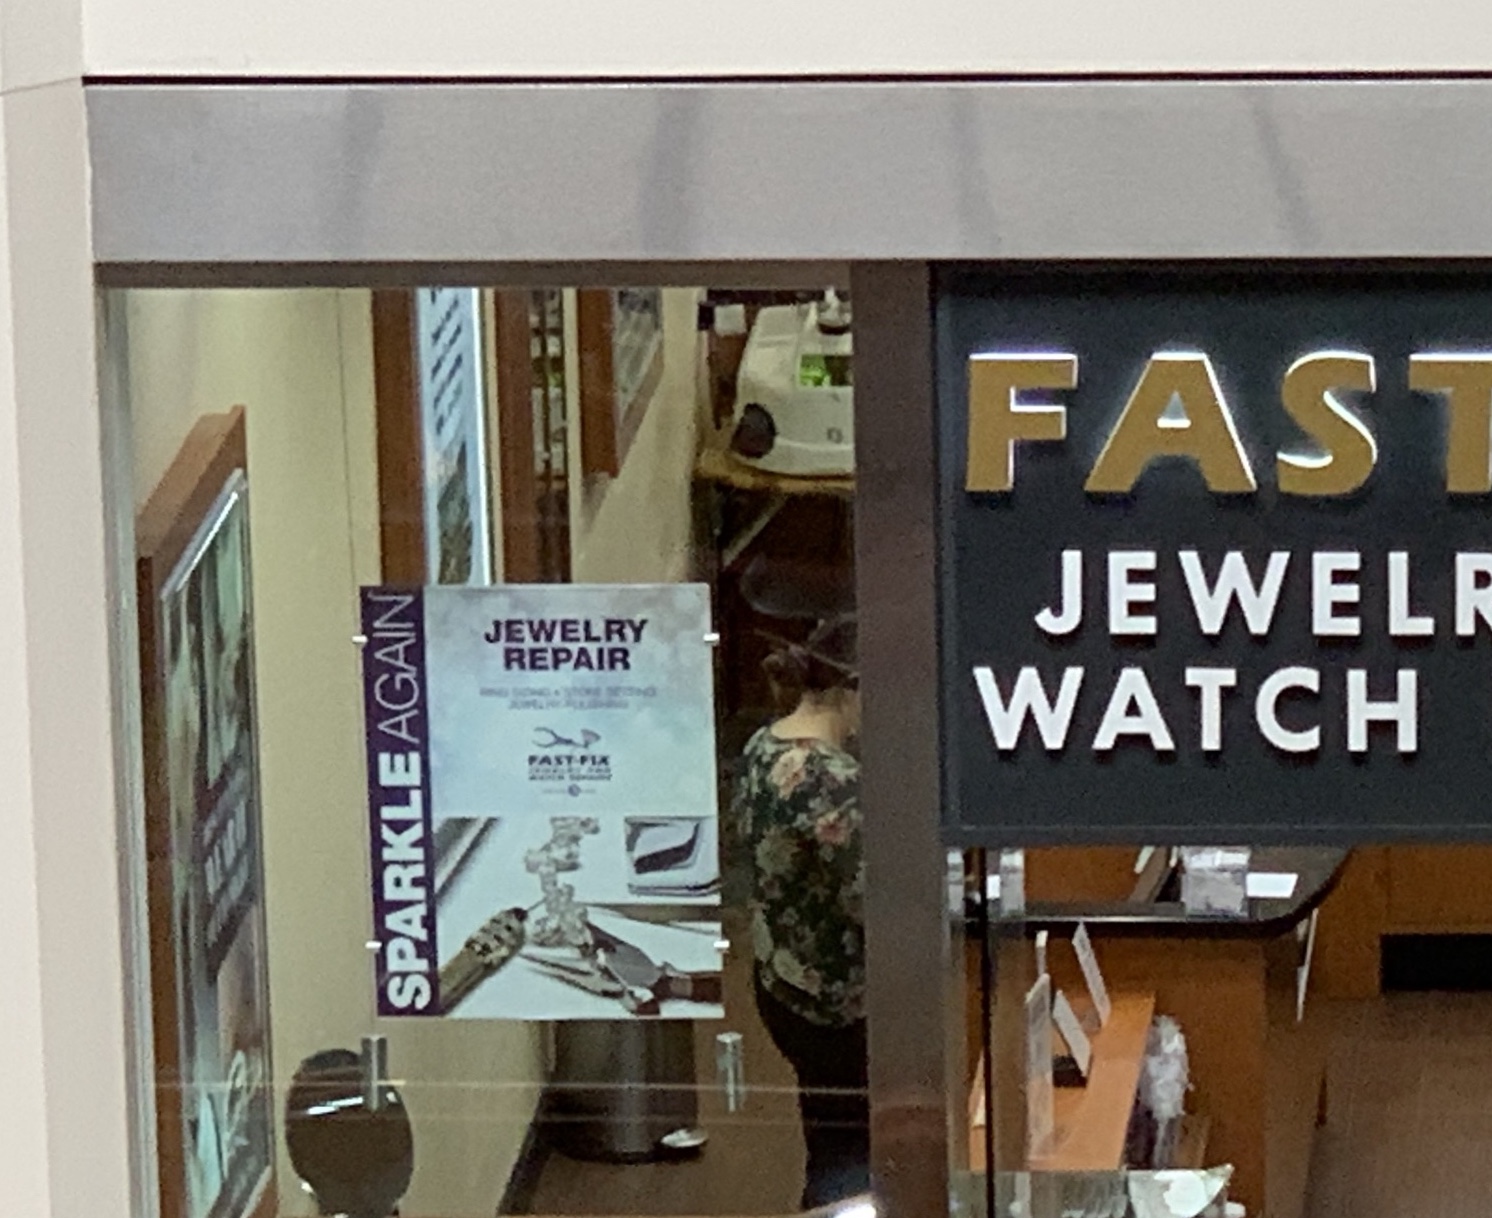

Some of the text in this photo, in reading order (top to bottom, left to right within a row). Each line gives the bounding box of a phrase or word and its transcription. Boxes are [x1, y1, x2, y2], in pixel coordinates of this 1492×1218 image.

[484, 618, 648, 643] JEWELRY
[503, 646, 631, 671] REPAIR
[972, 665, 1420, 754] WATCH
[367, 589, 432, 1011] SPARKLE AGAIN
